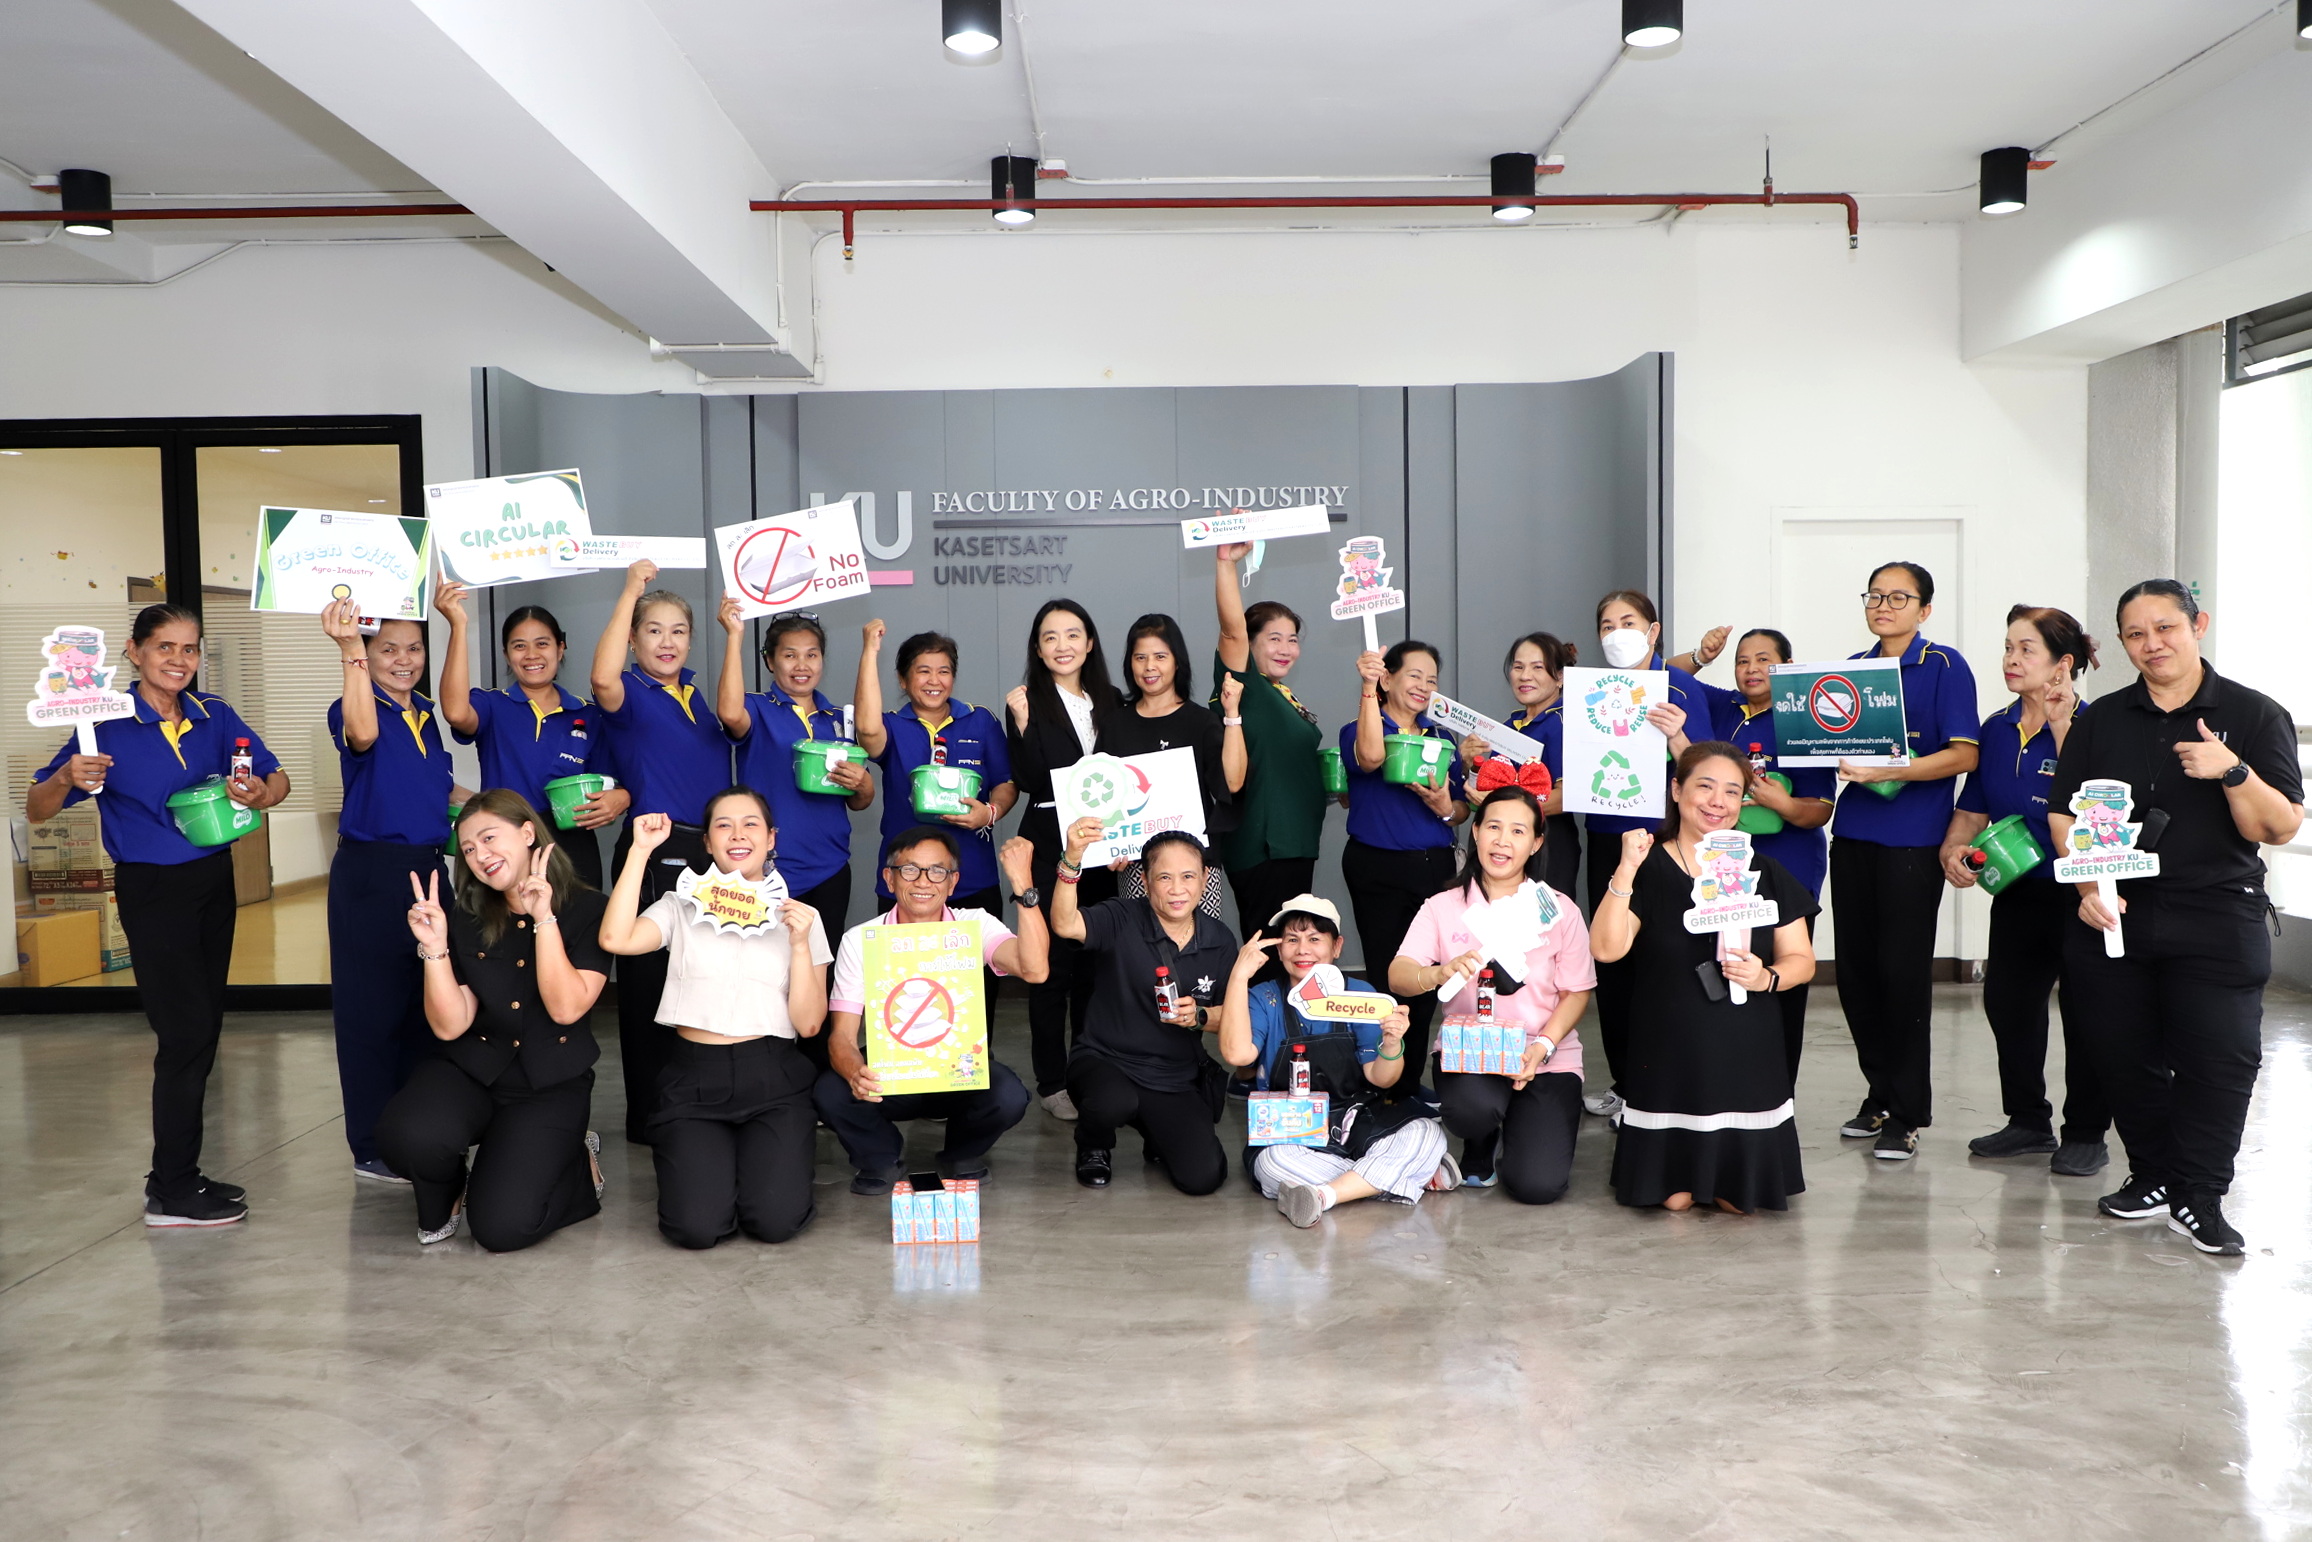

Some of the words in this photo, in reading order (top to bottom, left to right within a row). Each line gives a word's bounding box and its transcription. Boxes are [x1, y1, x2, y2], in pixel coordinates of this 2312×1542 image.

[932, 490, 1056, 513] FACULTY
[1064, 489, 1103, 512] OF
[1109, 485, 1349, 510] AGRO-INDUSTRY
[502, 502, 521, 521] AI
[460, 520, 571, 548] CIRCULAR
[582, 548, 619, 556] Delivery
[933, 534, 1068, 557] KASETSART
[274, 543, 342, 571] Green
[350, 542, 411, 580] Office
[829, 553, 860, 571] No
[312, 566, 374, 577] Agro-Industry
[933, 563, 1073, 586] UNIVERSITY
[813, 571, 864, 592] Foam
[1335, 604, 1366, 616] GREEN
[1367, 596, 1400, 609] OFFICE
[1596, 674, 1635, 689] RECYCLE
[47, 697, 101, 707] AGRO-INDUSTRY
[1863, 686, 1898, 708] โฟม
[36, 706, 80, 719] GREEN
[82, 702, 128, 714] OFFICE
[1629, 705, 1648, 733] REUSE
[1450, 712, 1476, 730] Delivery
[1586, 707, 1612, 734] REDUCE
[236, 812, 250, 823] MILO
[1144, 815, 1183, 834] BUY
[1110, 844, 1143, 857] Deliv
[2072, 854, 2126, 866] AGRO-INDUSTRY
[2060, 864, 2104, 877] GREEN
[2106, 860, 2154, 873] OFFICE
[710, 886, 755, 904] สุดยอด
[708, 900, 751, 920] นักขาย
[1690, 914, 1728, 927] GREEN
[1731, 907, 1772, 922] OFFICE
[1700, 903, 1748, 915] AGRO-INDUSTRY
[943, 929, 970, 950] เลิก
[1325, 1000, 1376, 1016] Recycle
